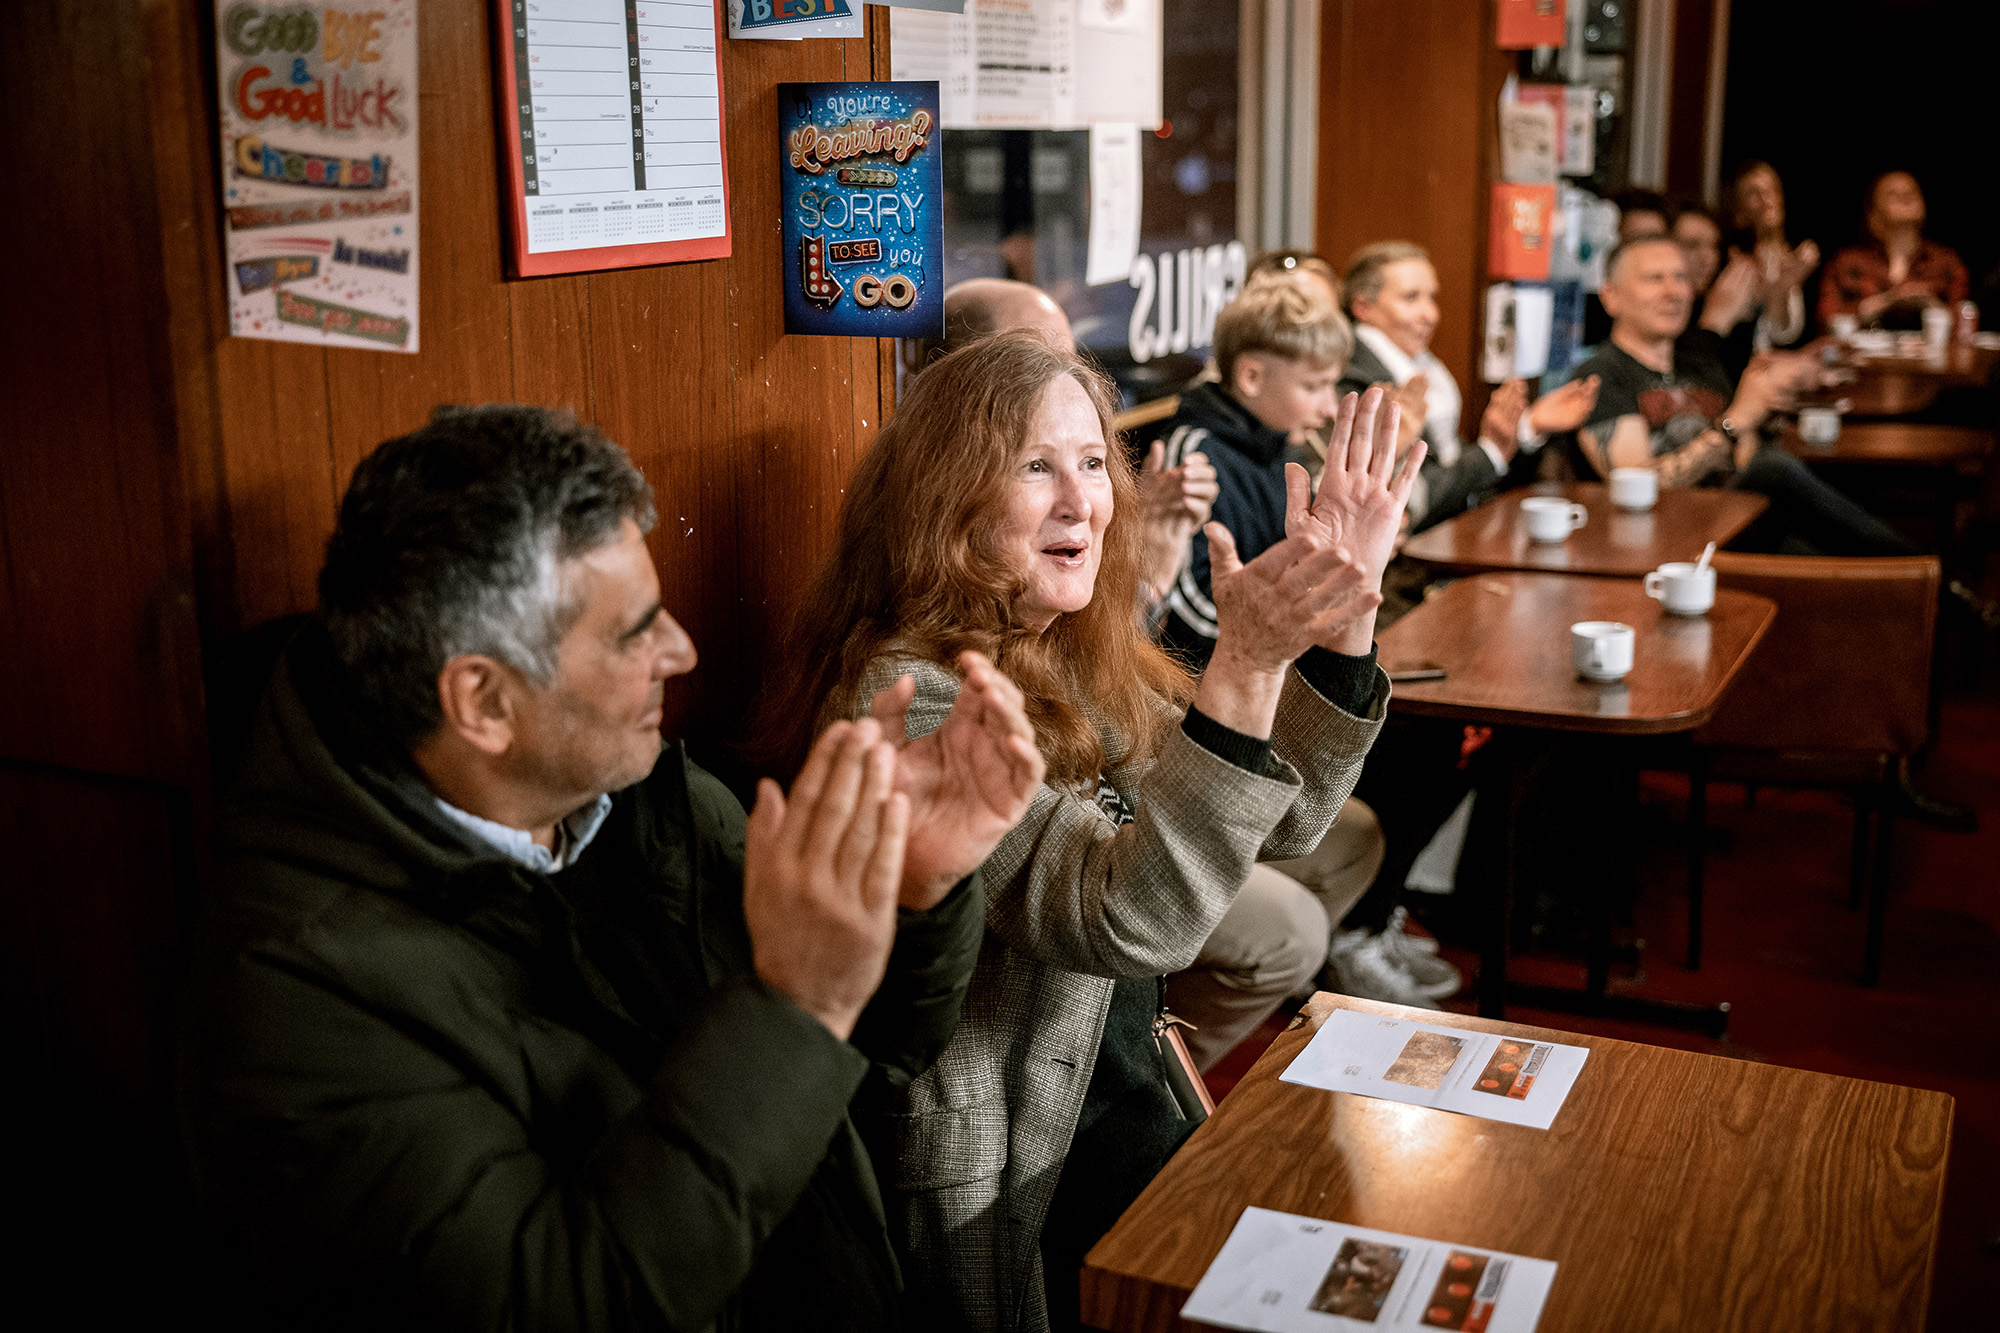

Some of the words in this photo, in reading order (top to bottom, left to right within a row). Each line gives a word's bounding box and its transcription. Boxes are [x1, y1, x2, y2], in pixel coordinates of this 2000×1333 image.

[638, 10, 646, 18] Sat
[516, 28, 525, 38] 10
[640, 34, 649, 42] Sun
[630, 57, 638, 66] 27
[290, 57, 311, 85] &
[532, 80, 543, 88] Sun
[631, 81, 639, 90] 28
[643, 82, 651, 90] Tue
[237, 65, 325, 128] Good
[521, 105, 530, 114] 13
[633, 105, 640, 114] 29
[644, 105, 654, 113] Wed
[523, 130, 532, 139] 14
[536, 130, 547, 138] Tue
[634, 129, 641, 137] 30
[790, 110, 932, 174] Leaving?
[525, 155, 534, 165] 15
[635, 152, 642, 161] 31
[527, 180, 537, 189] 16
[799, 191, 924, 229] SORRY
[831, 244, 850, 258] TO
[853, 242, 878, 257] SEE
[889, 249, 922, 268] you
[853, 274, 916, 308] GO
